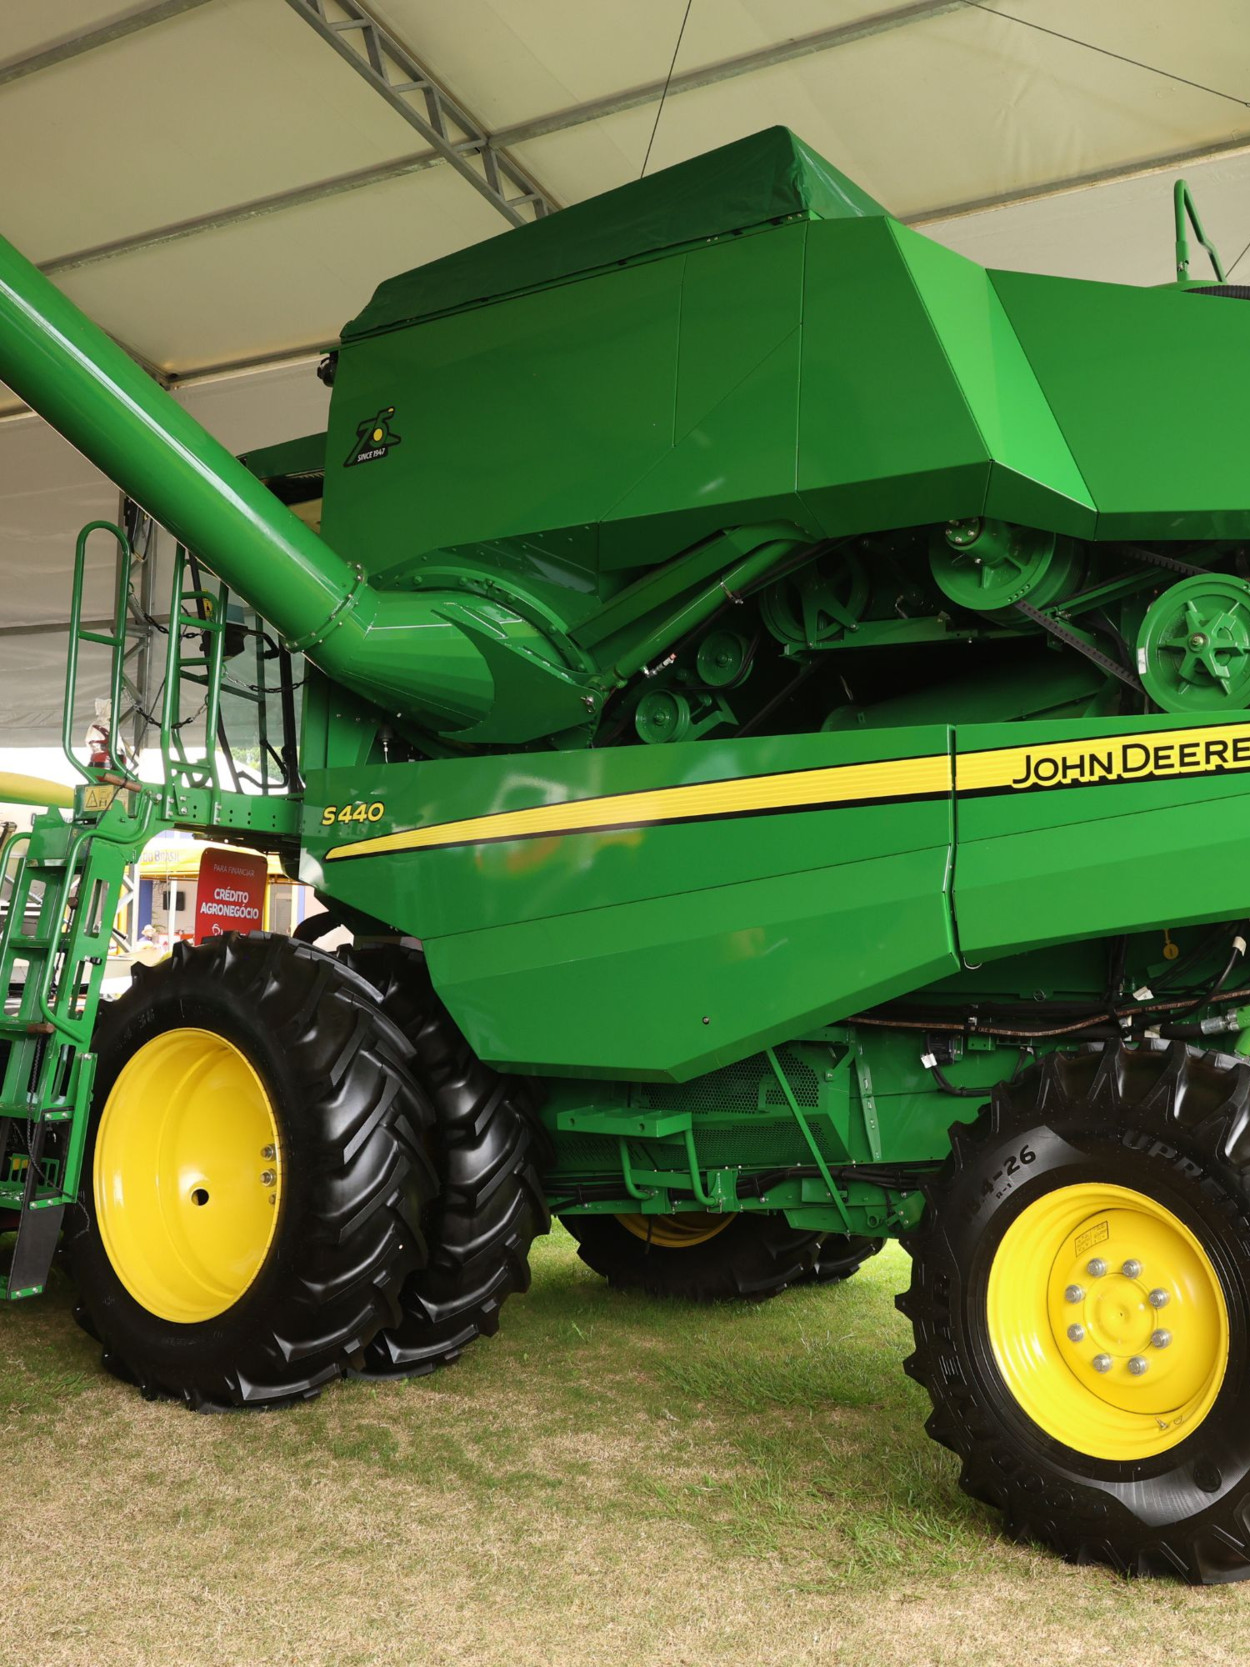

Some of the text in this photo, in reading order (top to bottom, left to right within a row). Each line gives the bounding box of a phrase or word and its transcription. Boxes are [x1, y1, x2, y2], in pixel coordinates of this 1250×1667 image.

[357, 448, 386, 462] SINCE 1947
[1012, 751, 1113, 785] JOHN
[321, 801, 385, 827] S440
[213, 863, 227, 872] PARA
[214, 886, 249, 904] CRÉDITO
[200, 903, 260, 920] AGRONEGÓCIO
